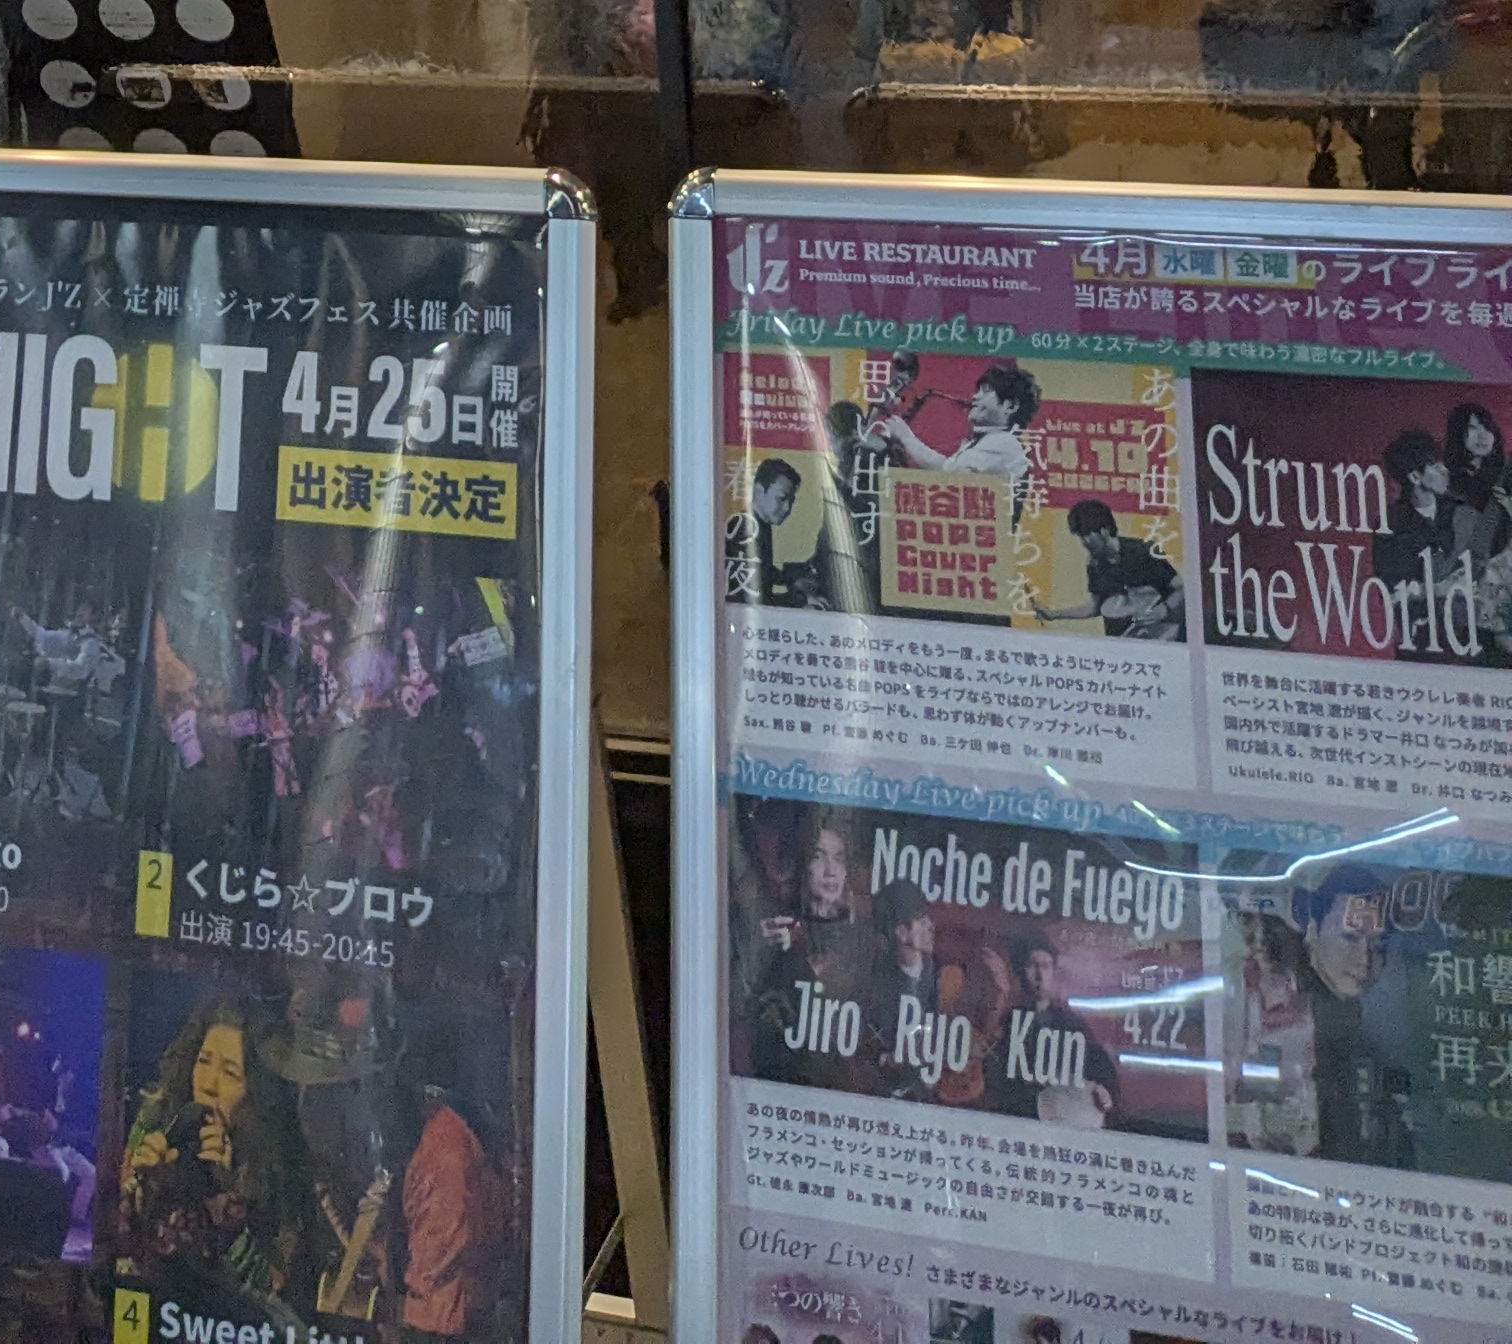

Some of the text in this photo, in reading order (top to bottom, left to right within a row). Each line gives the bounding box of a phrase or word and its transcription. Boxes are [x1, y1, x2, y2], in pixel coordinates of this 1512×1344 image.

[799, 239, 857, 261] LIVE
[863, 242, 1038, 269] RESTAURANT
[799, 269, 867, 284] Premium
[389, 298, 513, 336] 共催企画
[834, 313, 897, 339] Live
[906, 315, 968, 348] pick
[976, 324, 1015, 351] up
[289, 459, 508, 525] 出演者決定
[1205, 421, 1390, 536] Strum
[146, 858, 163, 890] 2
[870, 827, 991, 910] Noche
[1002, 841, 1053, 915] de
[1061, 849, 1186, 941] Fuego
[179, 909, 395, 969] 出演 19:45-20:15
[784, 980, 1087, 1089] Jiro Ryo Kan
[738, 1225, 817, 1260] Other
[825, 1240, 915, 1278] Lives!
[121, 1299, 141, 1332] 4
